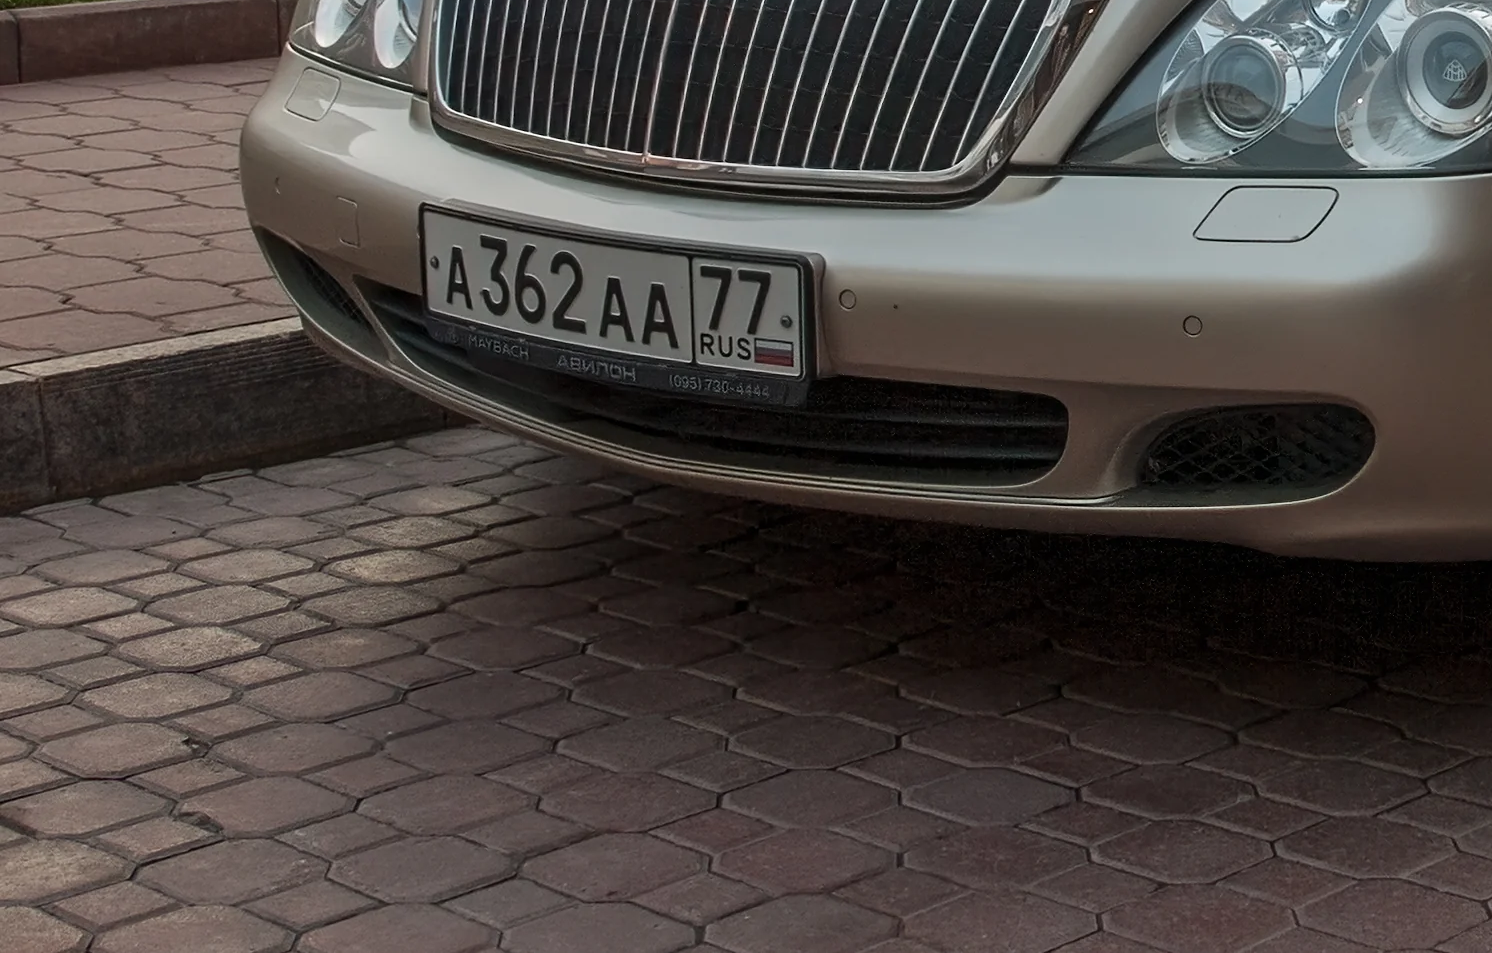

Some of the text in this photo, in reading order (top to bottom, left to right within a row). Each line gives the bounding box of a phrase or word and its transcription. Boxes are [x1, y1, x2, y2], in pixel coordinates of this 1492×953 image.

[700, 265, 772, 335] 77
[468, 334, 530, 361] MAYBACH
[700, 333, 752, 361] RUS
